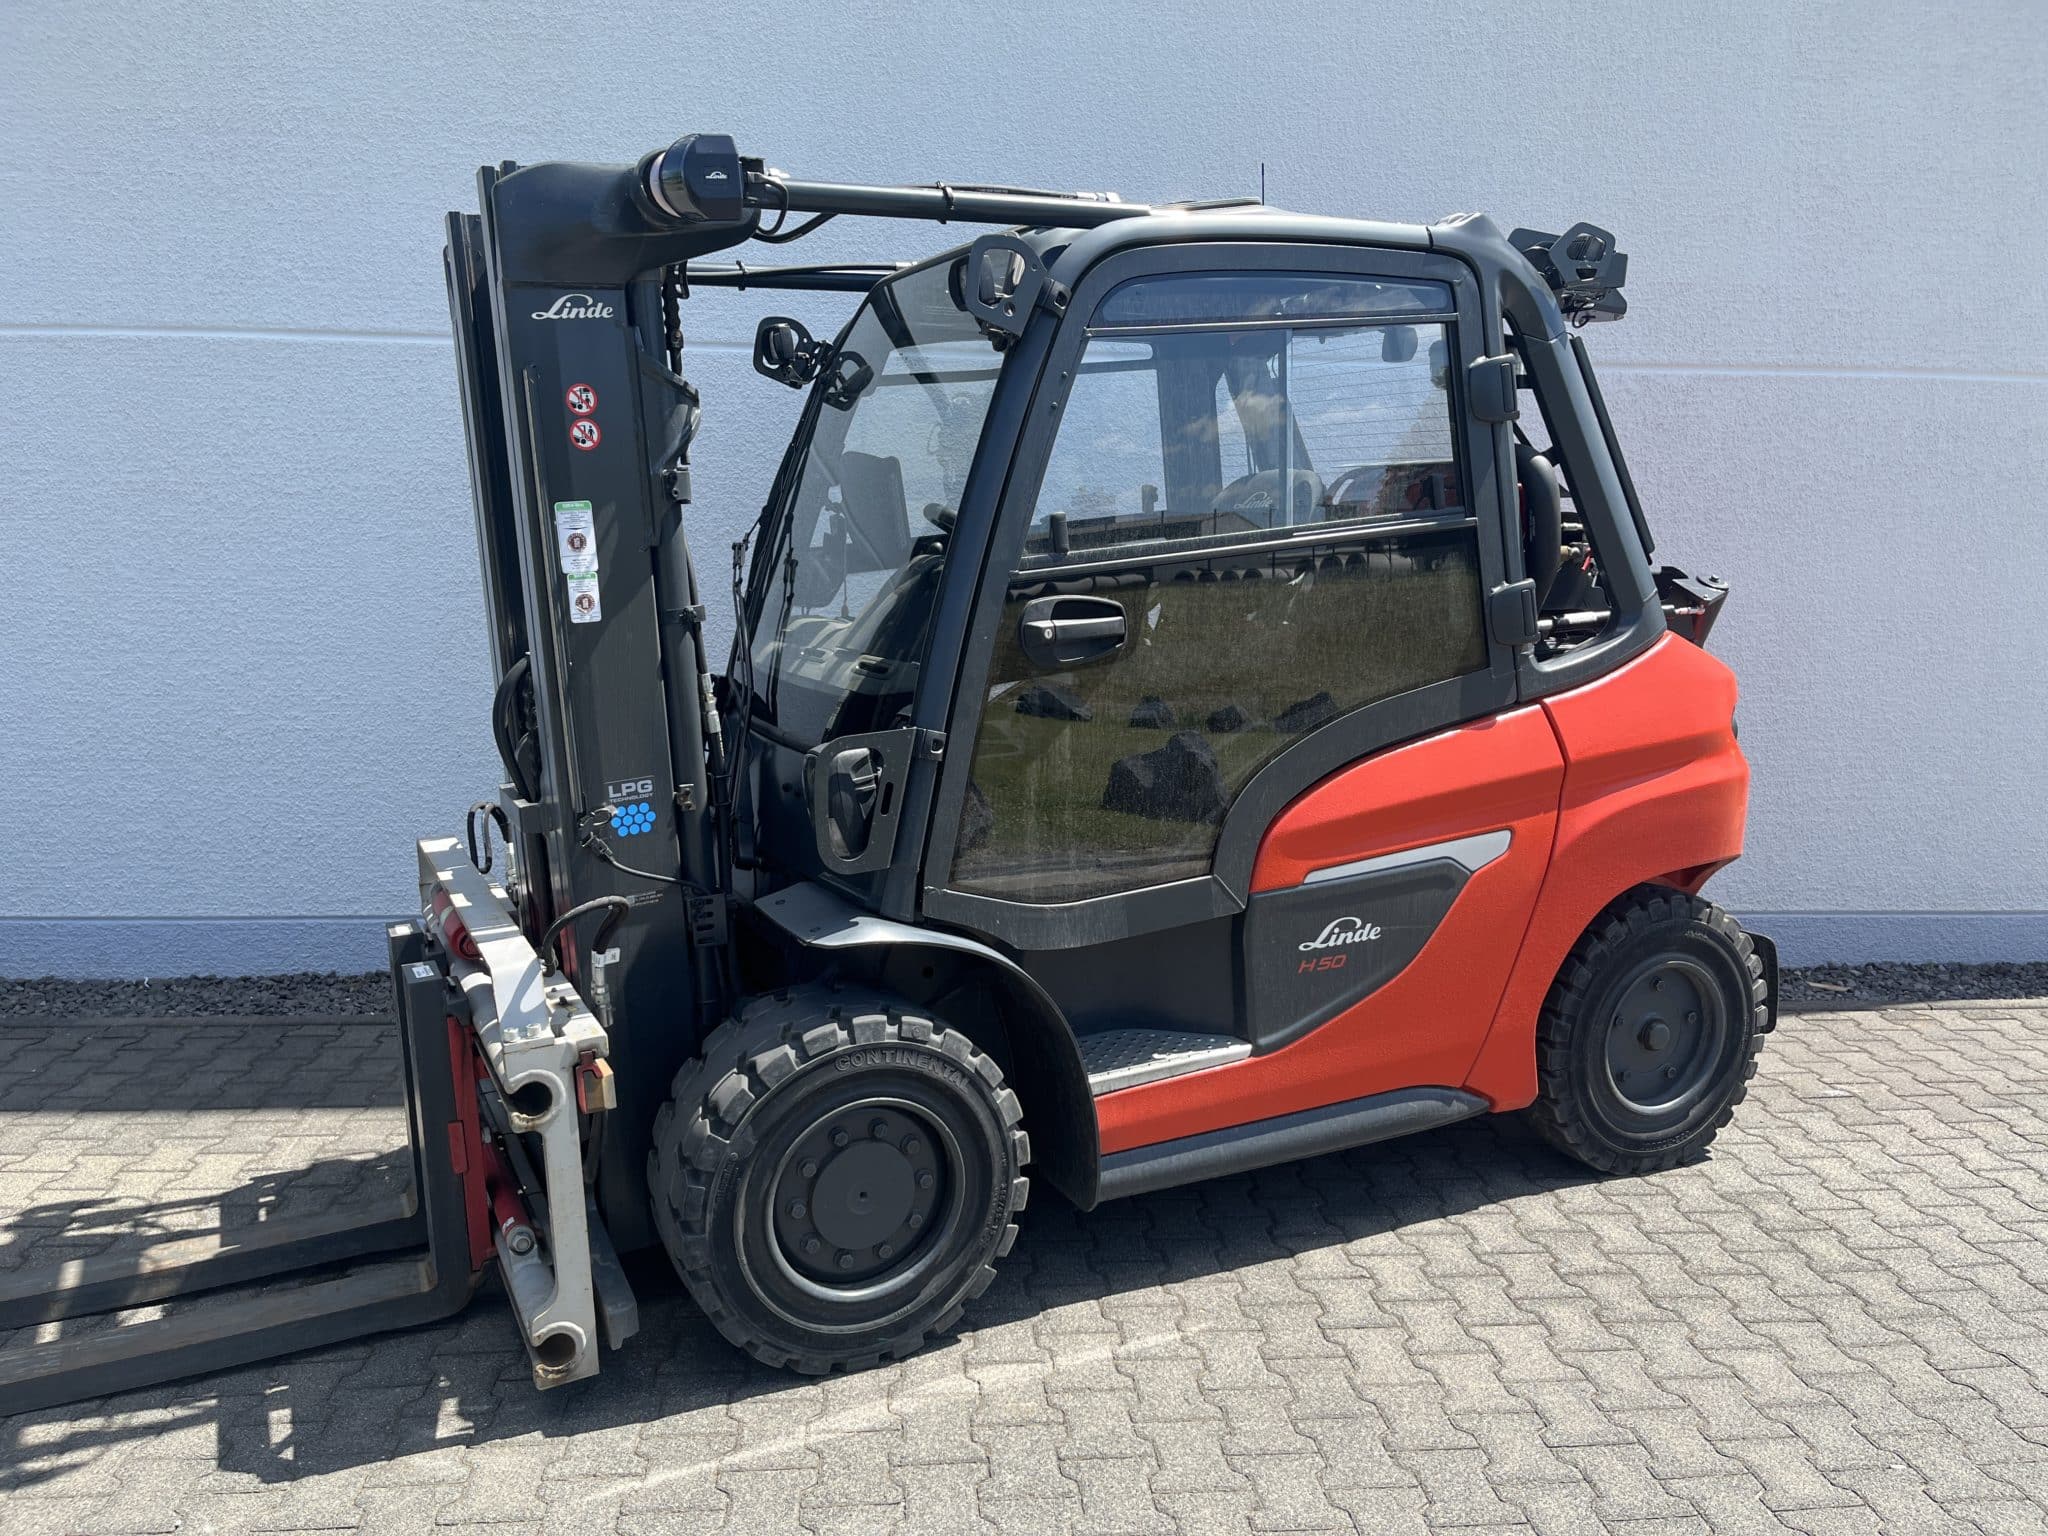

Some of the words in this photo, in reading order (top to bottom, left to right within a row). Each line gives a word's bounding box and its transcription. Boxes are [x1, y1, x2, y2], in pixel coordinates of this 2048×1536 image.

[531, 293, 615, 320] Linde
[608, 779, 653, 797] LPG
[610, 793, 653, 803] TECHNOLOGY
[1298, 916, 1381, 951] Linde
[1298, 954, 1347, 974] H50
[835, 1049, 971, 1092] CONTINENTAL
